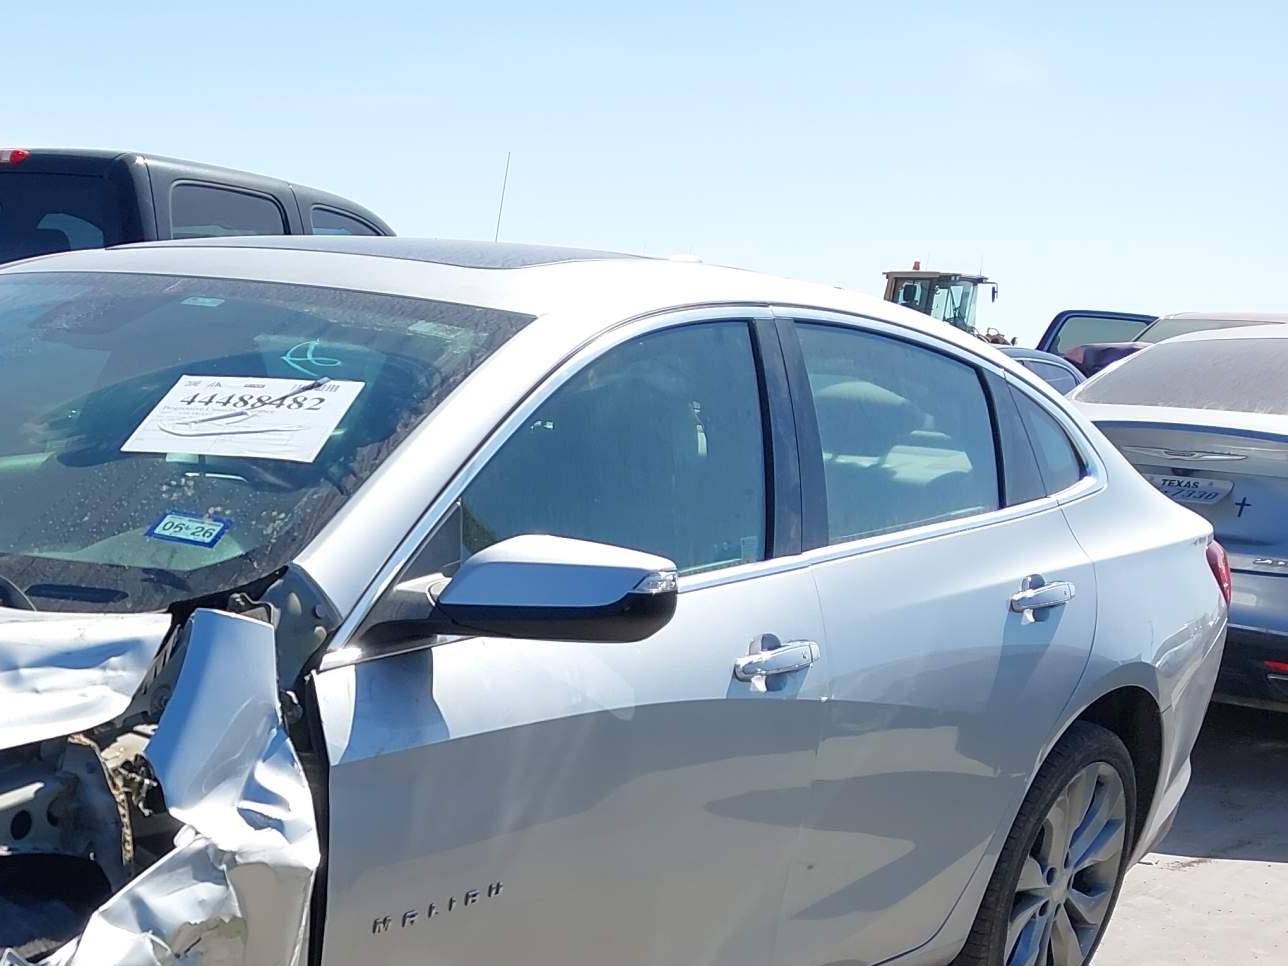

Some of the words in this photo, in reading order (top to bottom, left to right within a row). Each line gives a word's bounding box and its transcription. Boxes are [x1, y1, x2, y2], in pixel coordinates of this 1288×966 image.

[180, 392, 326, 411] 44488482
[1161, 479, 1200, 488] TEXAS
[162, 521, 185, 533] 05
[190, 526, 216, 538] 26
